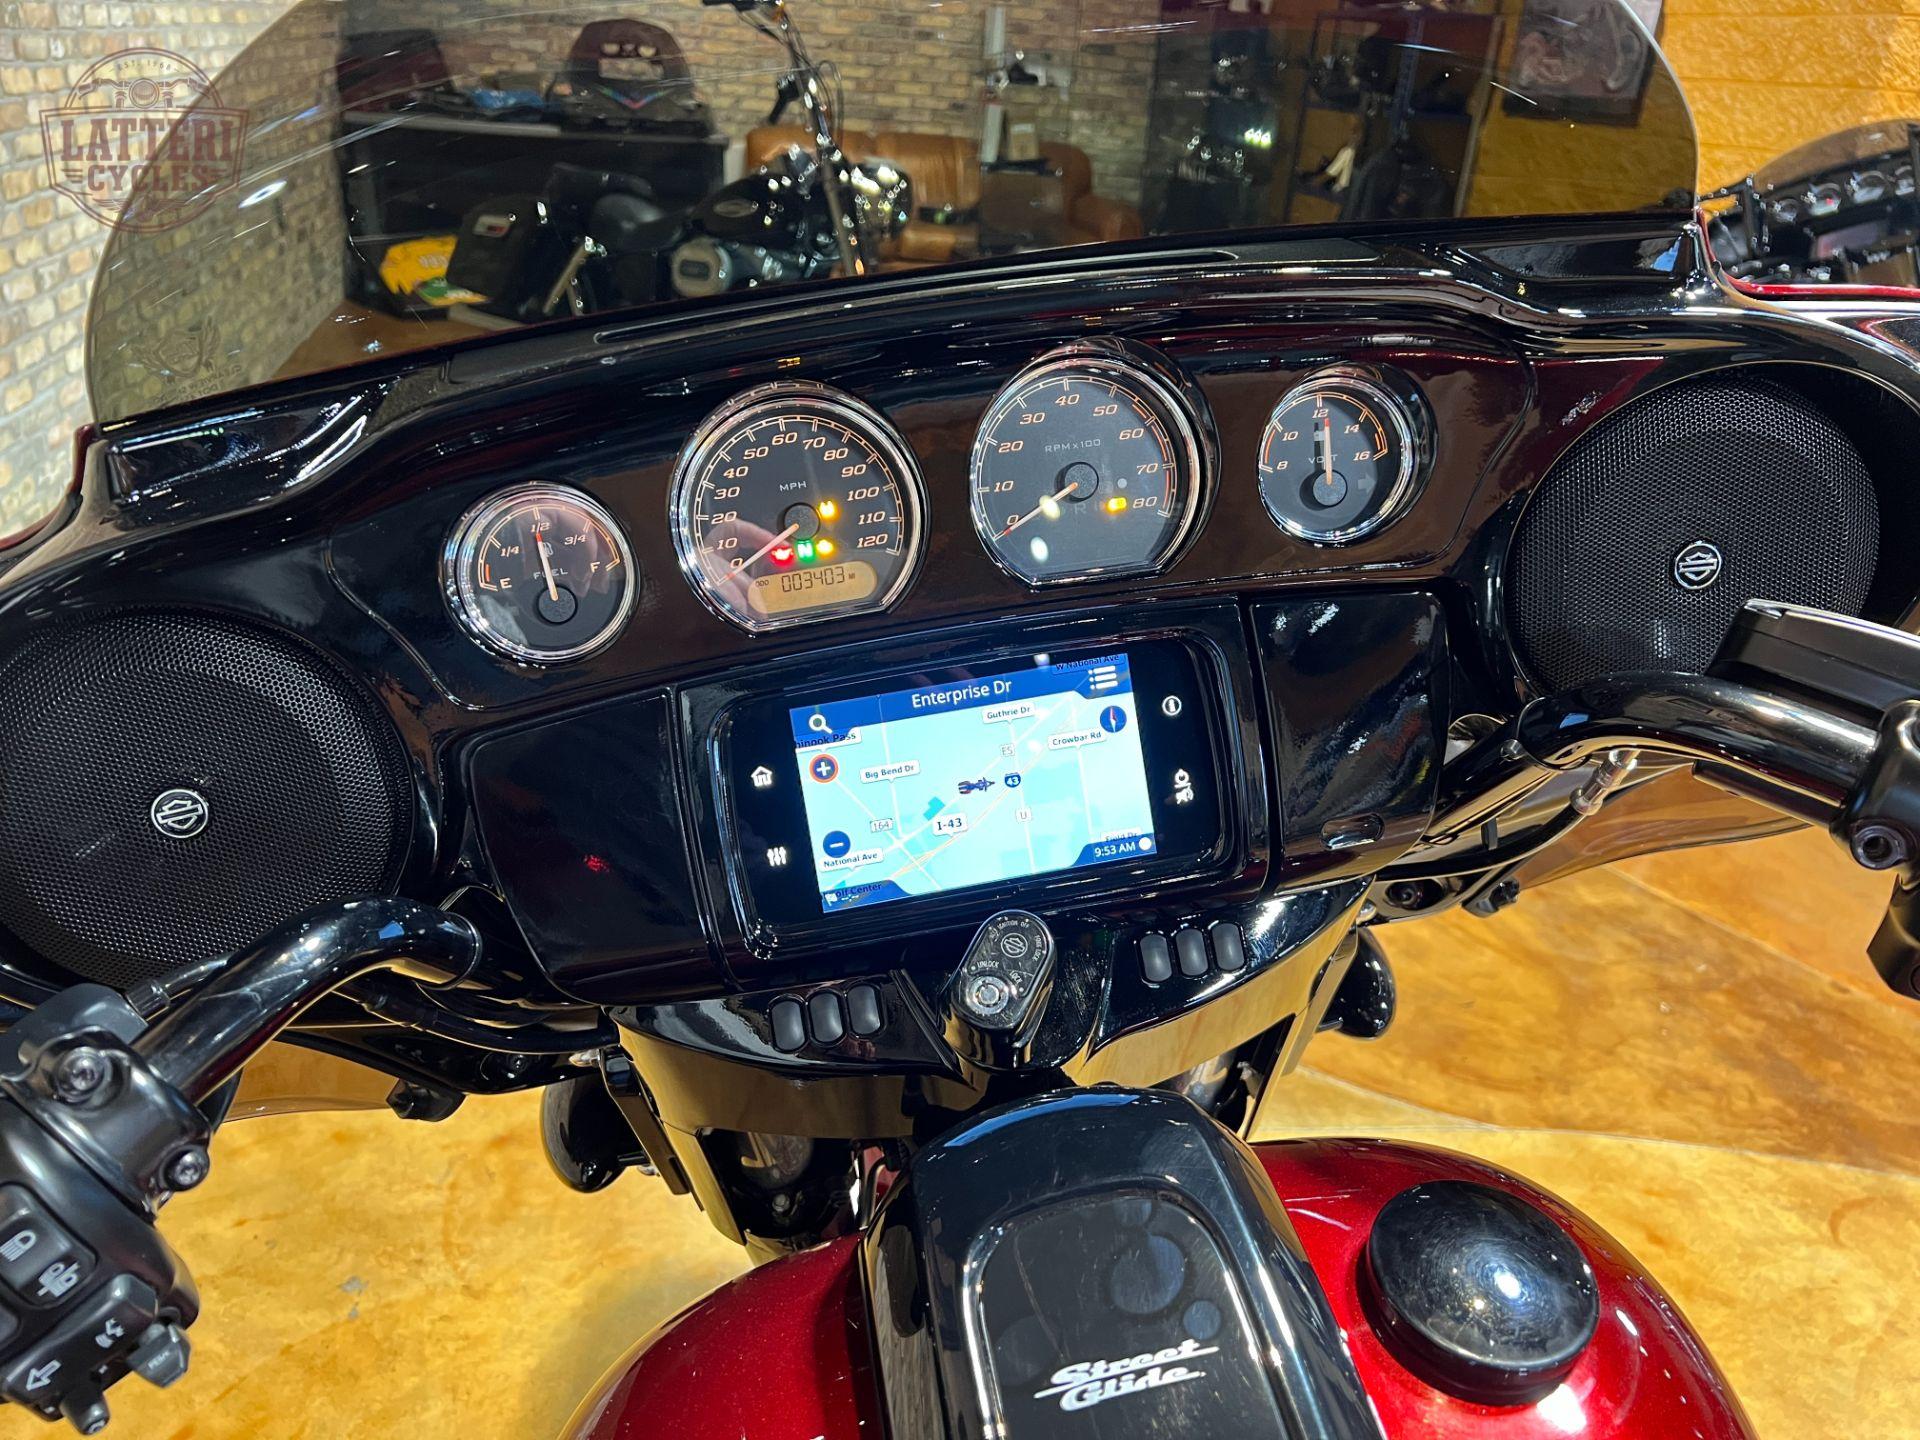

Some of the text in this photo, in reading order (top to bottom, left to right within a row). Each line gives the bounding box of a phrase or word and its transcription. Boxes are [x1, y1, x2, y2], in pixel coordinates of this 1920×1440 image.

[1055, 394, 1080, 406] 40
[1092, 404, 1118, 416] 50
[1312, 409, 1329, 419] 12
[1019, 412, 1045, 425] 30
[1119, 428, 1144, 440] 60
[1343, 424, 1360, 434] 14
[771, 432, 798, 446] 60
[1282, 431, 1299, 442] 10
[802, 436, 826, 451] 70
[998, 441, 1023, 453] 20
[743, 446, 769, 460] 50
[823, 447, 849, 461] 80
[1308, 454, 1338, 464] VOT
[1353, 451, 1370, 461] 16
[723, 466, 749, 479] 40
[841, 464, 867, 478] 90
[1136, 463, 1158, 475] 70
[1276, 461, 1288, 471] 8
[779, 480, 807, 492] MPH
[994, 481, 1014, 493] 10
[714, 486, 740, 500] 30
[847, 486, 880, 502] 100
[1132, 497, 1158, 509] 80
[711, 511, 737, 524] 20
[857, 511, 886, 525] 110
[530, 522, 551, 533] 1/2
[563, 533, 587, 545] 3/4
[716, 537, 738, 550] 10
[856, 533, 888, 549] 120
[500, 546, 520, 557] 1/4
[797, 540, 813, 558] N
[590, 561, 601, 573] F
[499, 578, 512, 589] E
[781, 566, 845, 593] 003403
[911, 679, 1013, 708] Enterprise Dr
[986, 706, 1031, 720] Guthrie Dr
[832, 732, 856, 742] Pass
[1052, 731, 1102, 746] Crowbar Rd
[865, 770, 879, 779] Big
[881, 766, 903, 776] Bend
[1006, 775, 1020, 786] 43
[872, 820, 891, 831] 164
[937, 818, 963, 831] I-43
[1095, 842, 1136, 858] 9:53 AM
[823, 852, 878, 868] National Ave
[1036, 1339, 1217, 1397] Street
[1059, 1366, 1206, 1412] Glide
